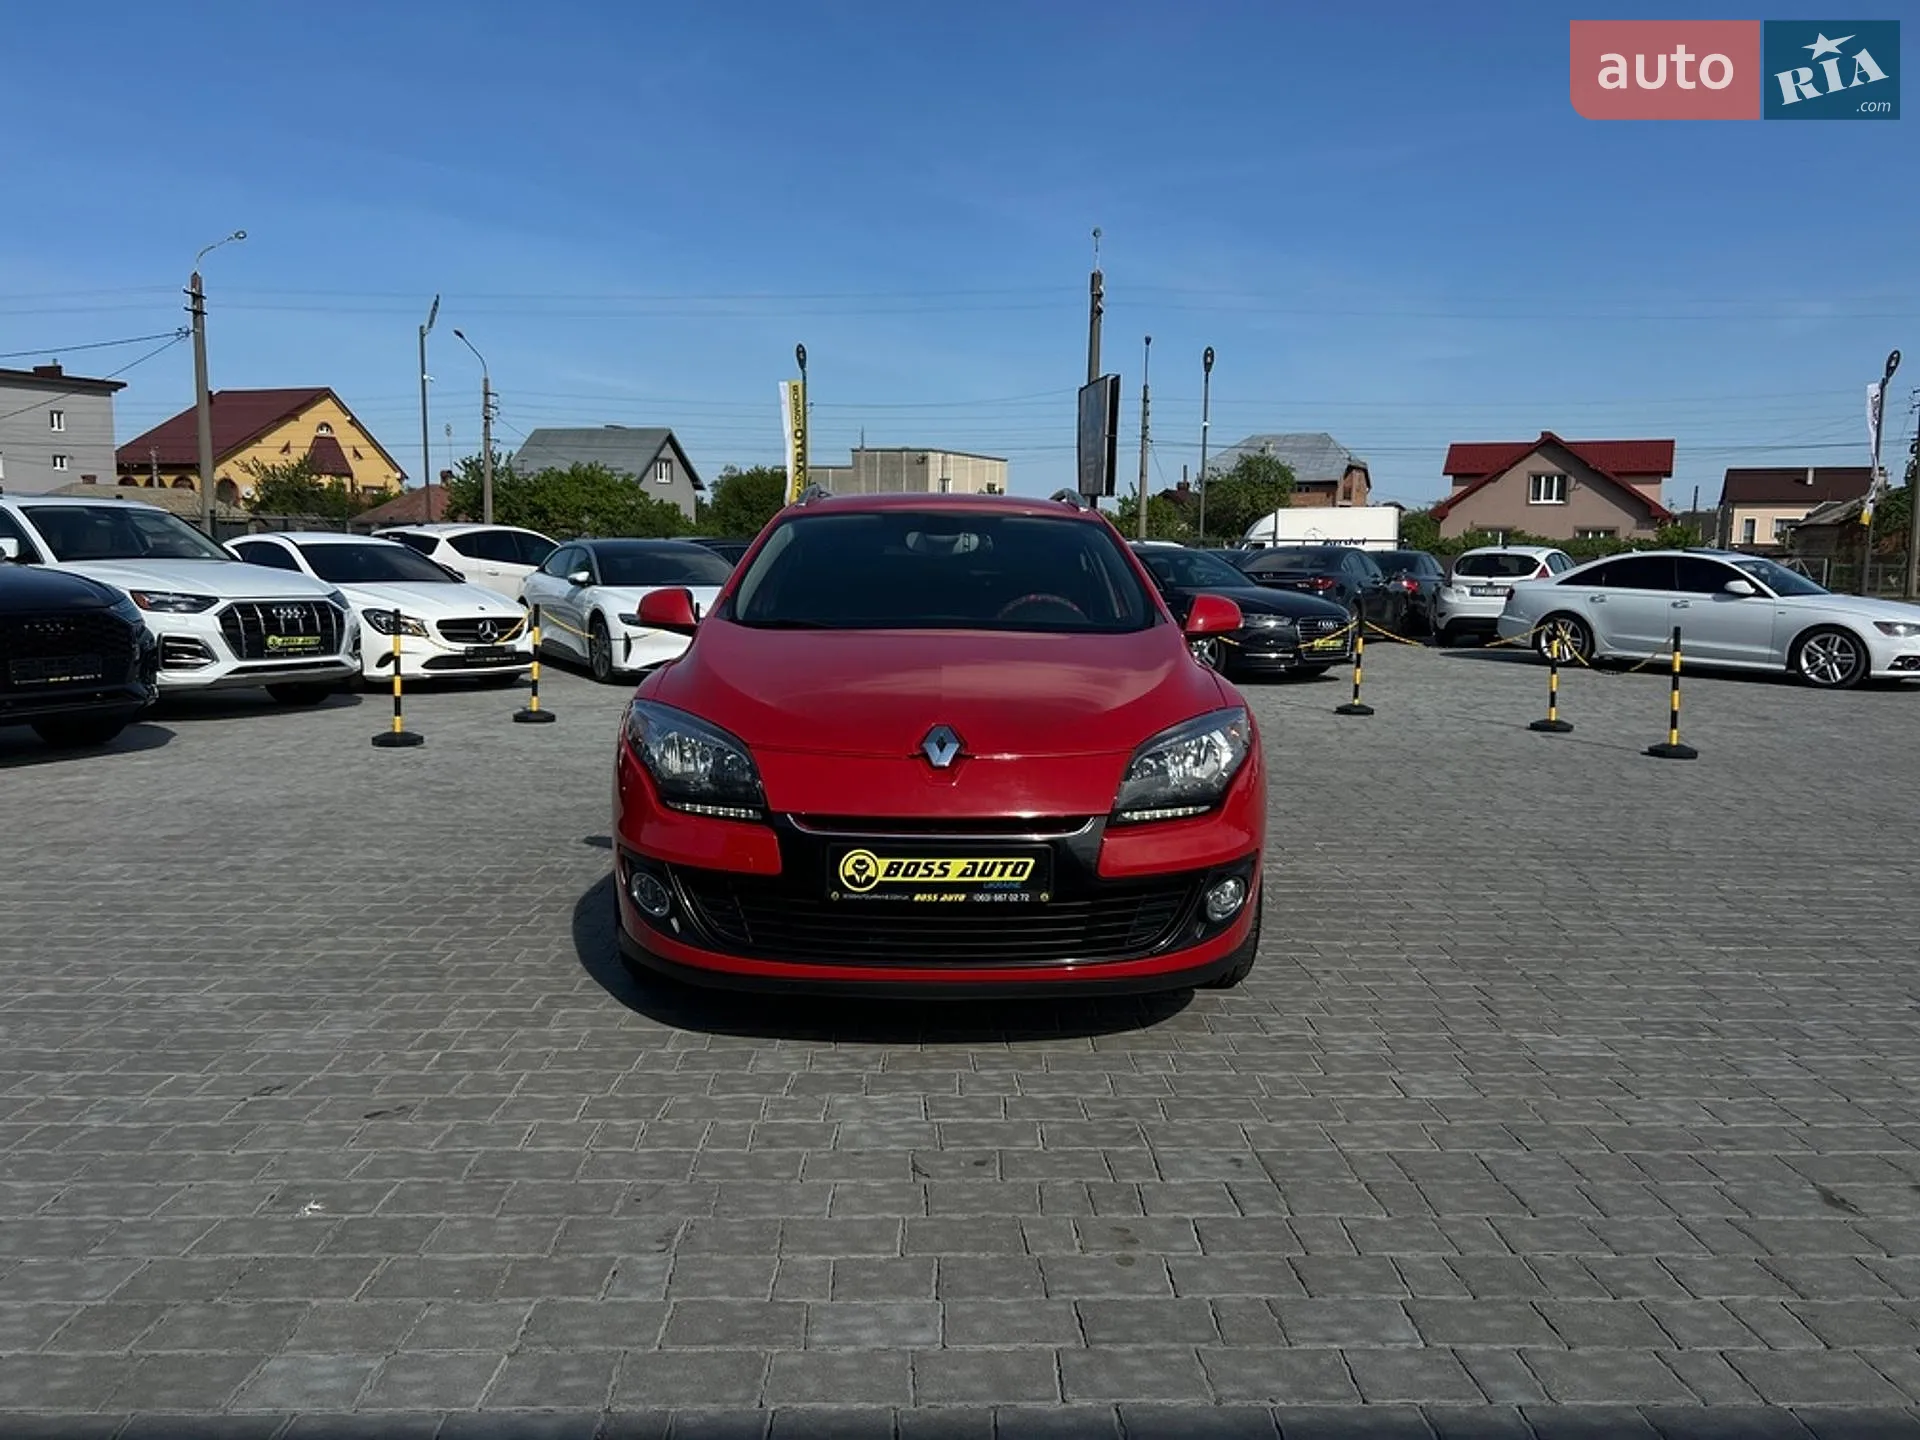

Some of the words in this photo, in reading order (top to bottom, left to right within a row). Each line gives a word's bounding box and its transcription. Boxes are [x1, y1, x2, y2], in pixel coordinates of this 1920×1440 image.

[882, 861, 953, 878] BOSS
[956, 861, 1030, 878] AUTO
[914, 893, 938, 902] BOSS
[939, 893, 966, 902] AUTO
